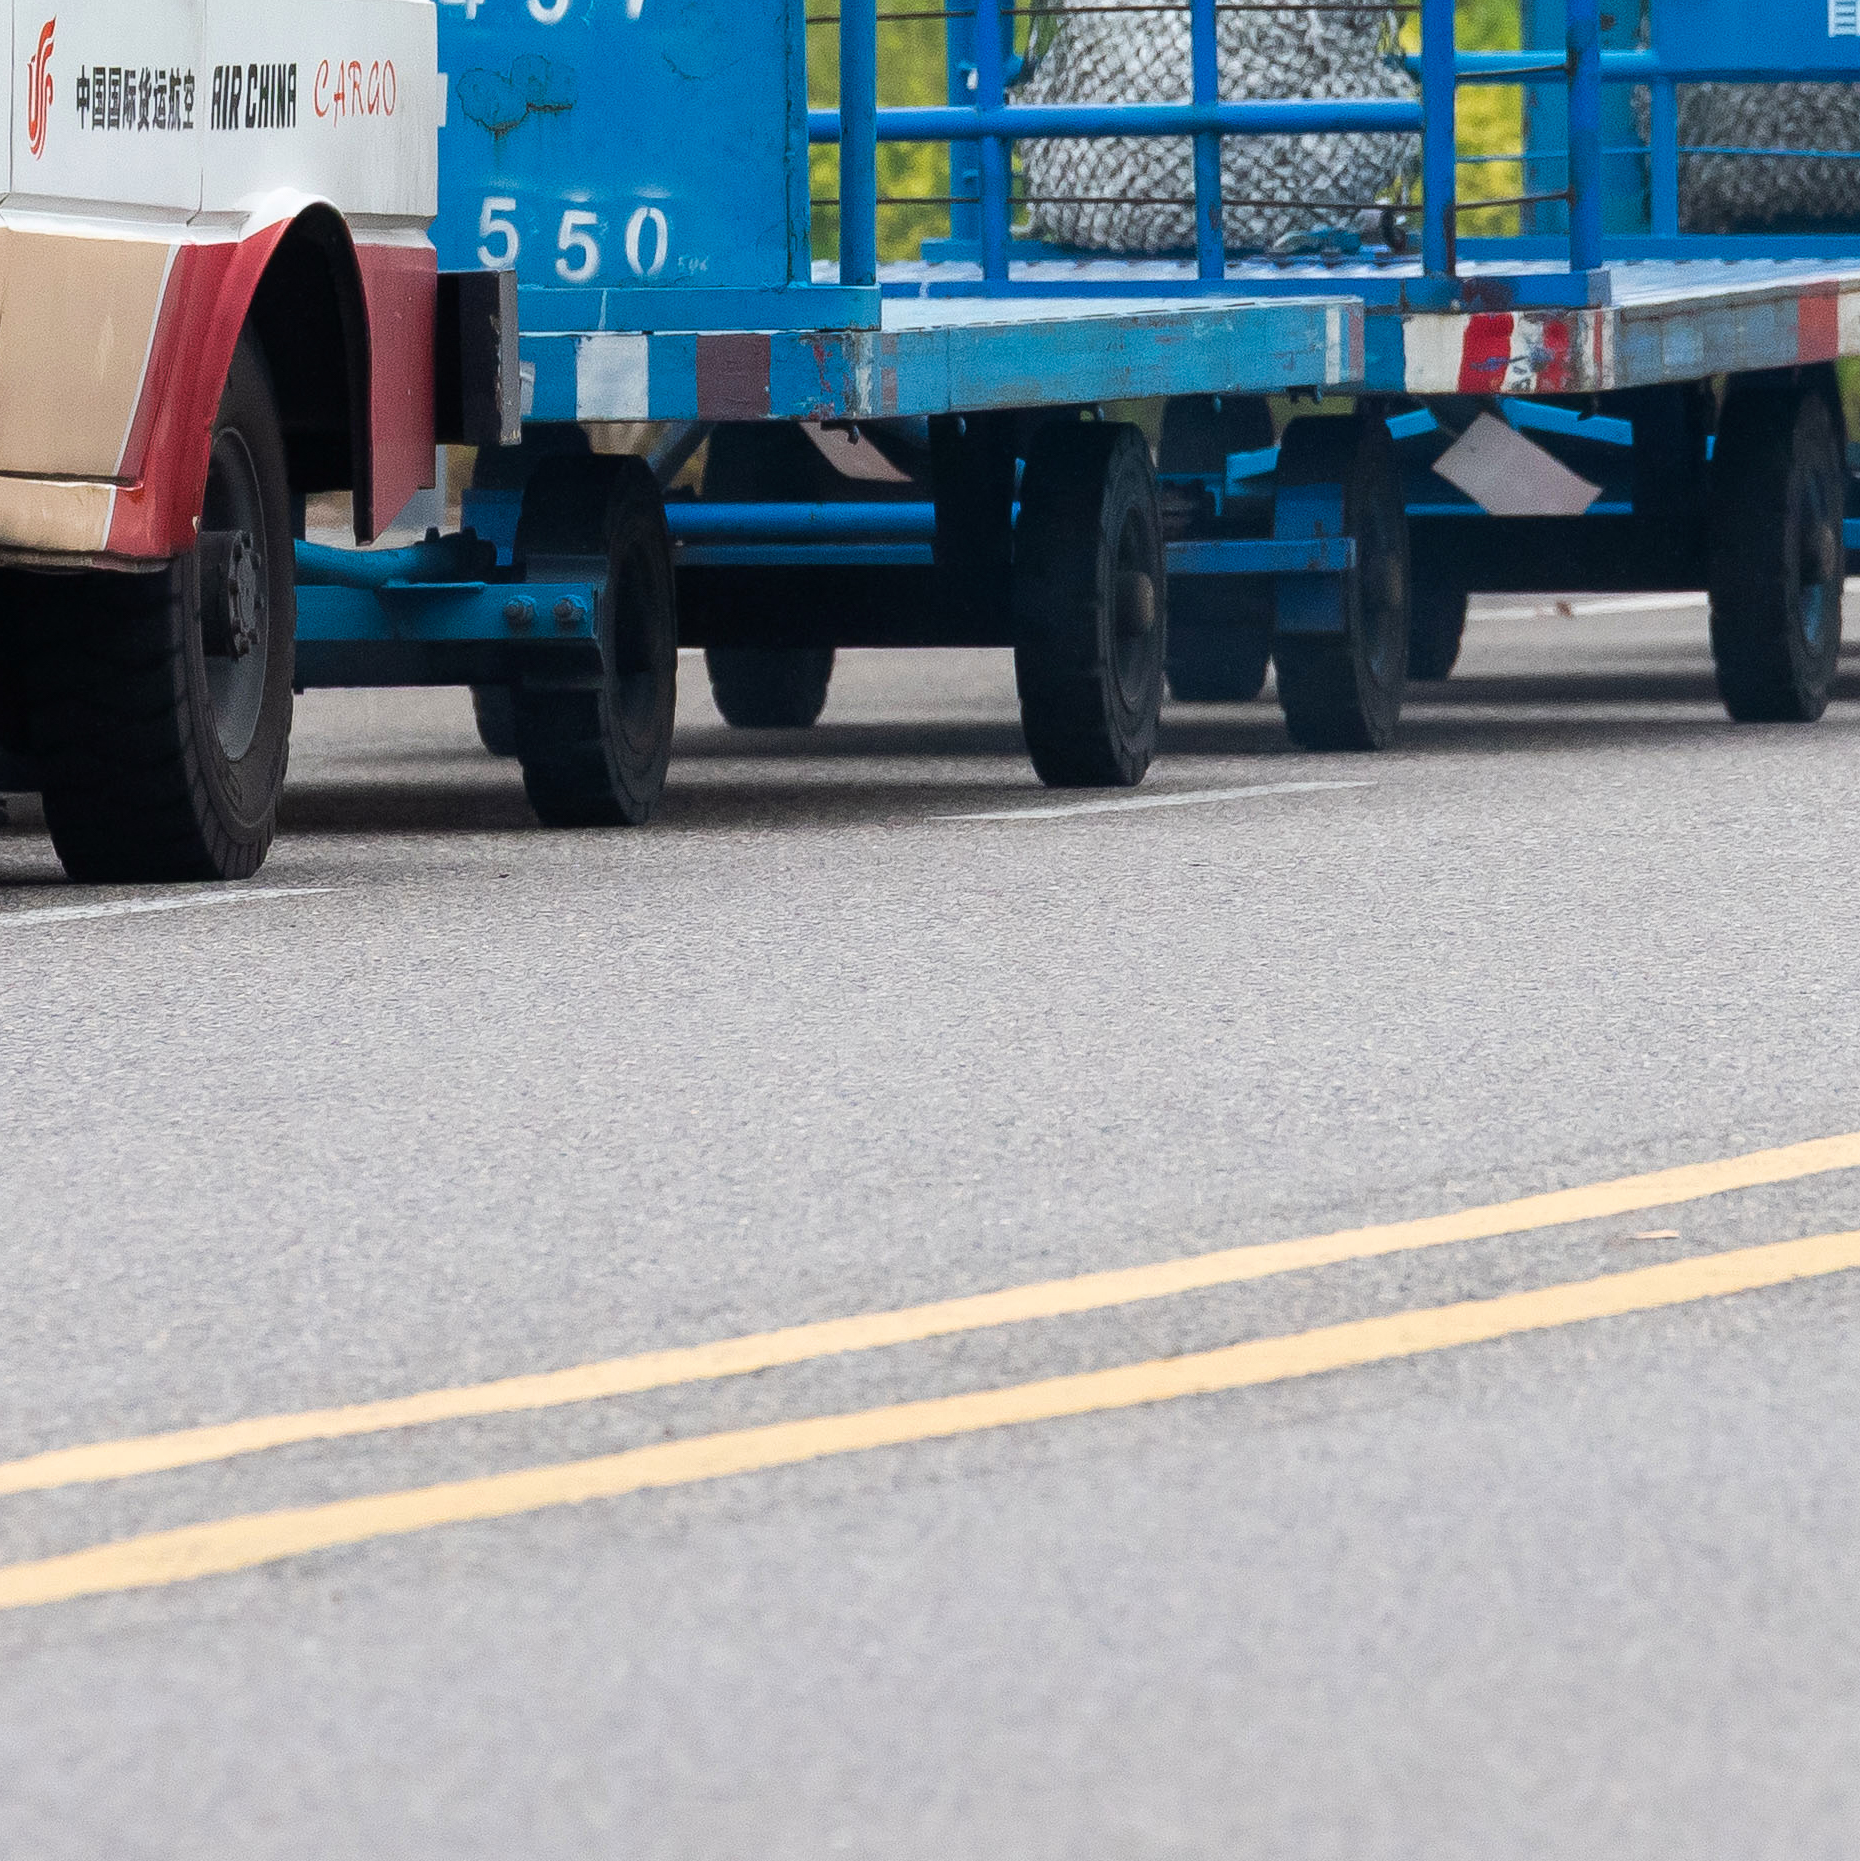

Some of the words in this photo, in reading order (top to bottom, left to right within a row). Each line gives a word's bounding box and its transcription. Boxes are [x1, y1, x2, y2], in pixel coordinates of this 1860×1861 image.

[76, 64, 195, 131] 中国国际货运航空
[210, 65, 242, 130] AIR
[244, 62, 297, 129] CHINA
[313, 59, 397, 128] CARGO
[477, 196, 668, 283] 550
